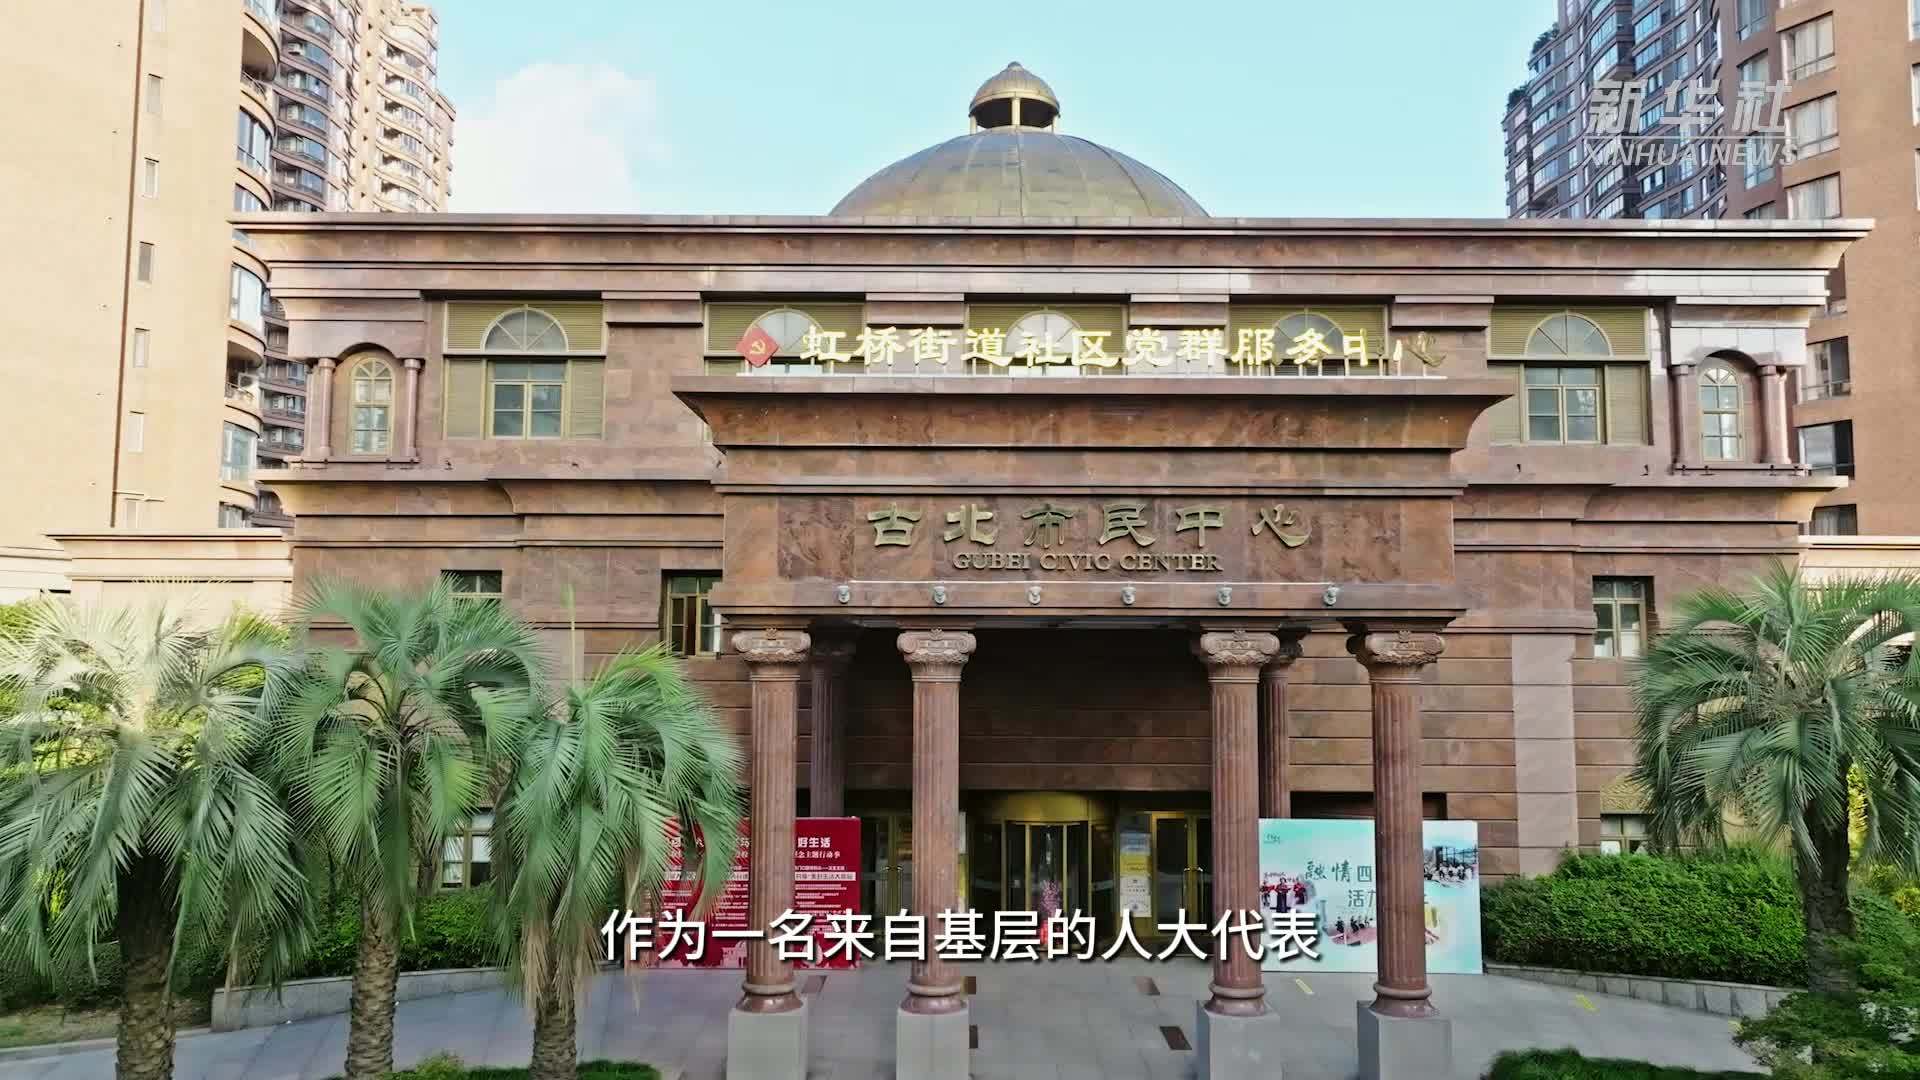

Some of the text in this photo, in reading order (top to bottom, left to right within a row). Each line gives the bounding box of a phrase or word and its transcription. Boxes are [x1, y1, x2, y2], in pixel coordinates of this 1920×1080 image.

[866, 502, 1313, 549] 古北市民中心
[952, 552, 1224, 572] GUBEI CIVIC CENTER
